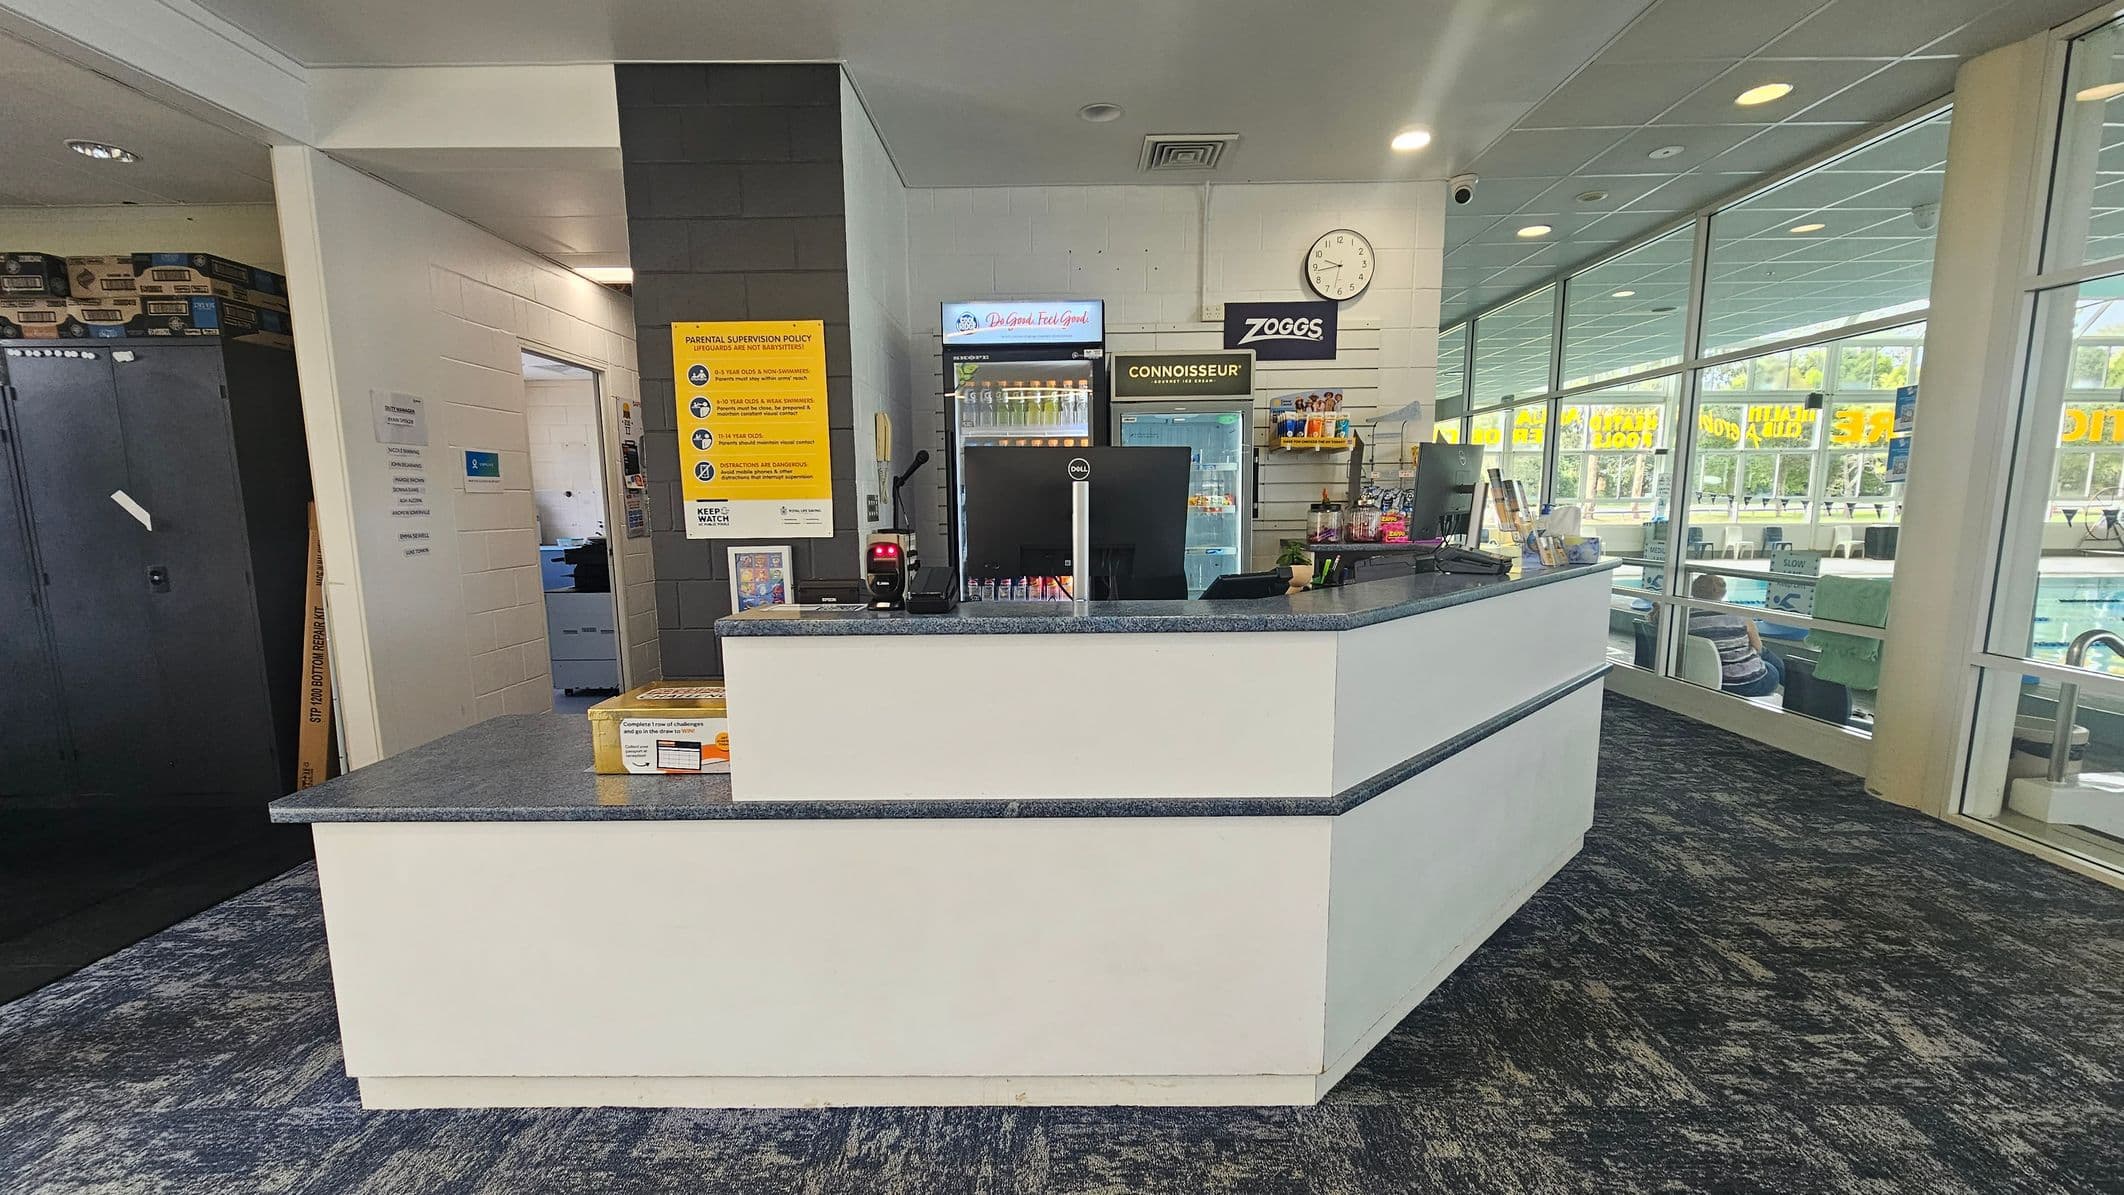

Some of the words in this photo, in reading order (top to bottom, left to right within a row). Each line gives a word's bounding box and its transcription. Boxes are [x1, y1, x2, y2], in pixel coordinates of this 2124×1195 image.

[1325, 240, 1330, 248] 11
[1337, 236, 1343, 244] 12
[1316, 250, 1322, 258] 10
[1362, 260, 1367, 268] 3
[985, 312, 1004, 327] Do
[1006, 312, 1034, 331] Good.
[1037, 311, 1058, 326] Feel
[1060, 310, 1089, 329] Good.
[1238, 318, 1323, 345] ZOGGS
[727, 335, 781, 343] SUPERVISION
[783, 334, 812, 342] POLICY
[762, 343, 804, 351] BABYSITTERS!
[1129, 365, 1238, 378] CONNOISSEUR
[1070, 465, 1088, 473] DELL
[697, 507, 720, 516] KEEP
[1783, 559, 1807, 568] SLOW
[314, 606, 325, 622] KIT
[313, 622, 325, 653] REPAIR
[312, 653, 324, 687] BOTTOM
[310, 688, 322, 707] 1200
[310, 708, 322, 723] STP
[623, 721, 651, 729] Complete
[673, 721, 704, 729] challenges
